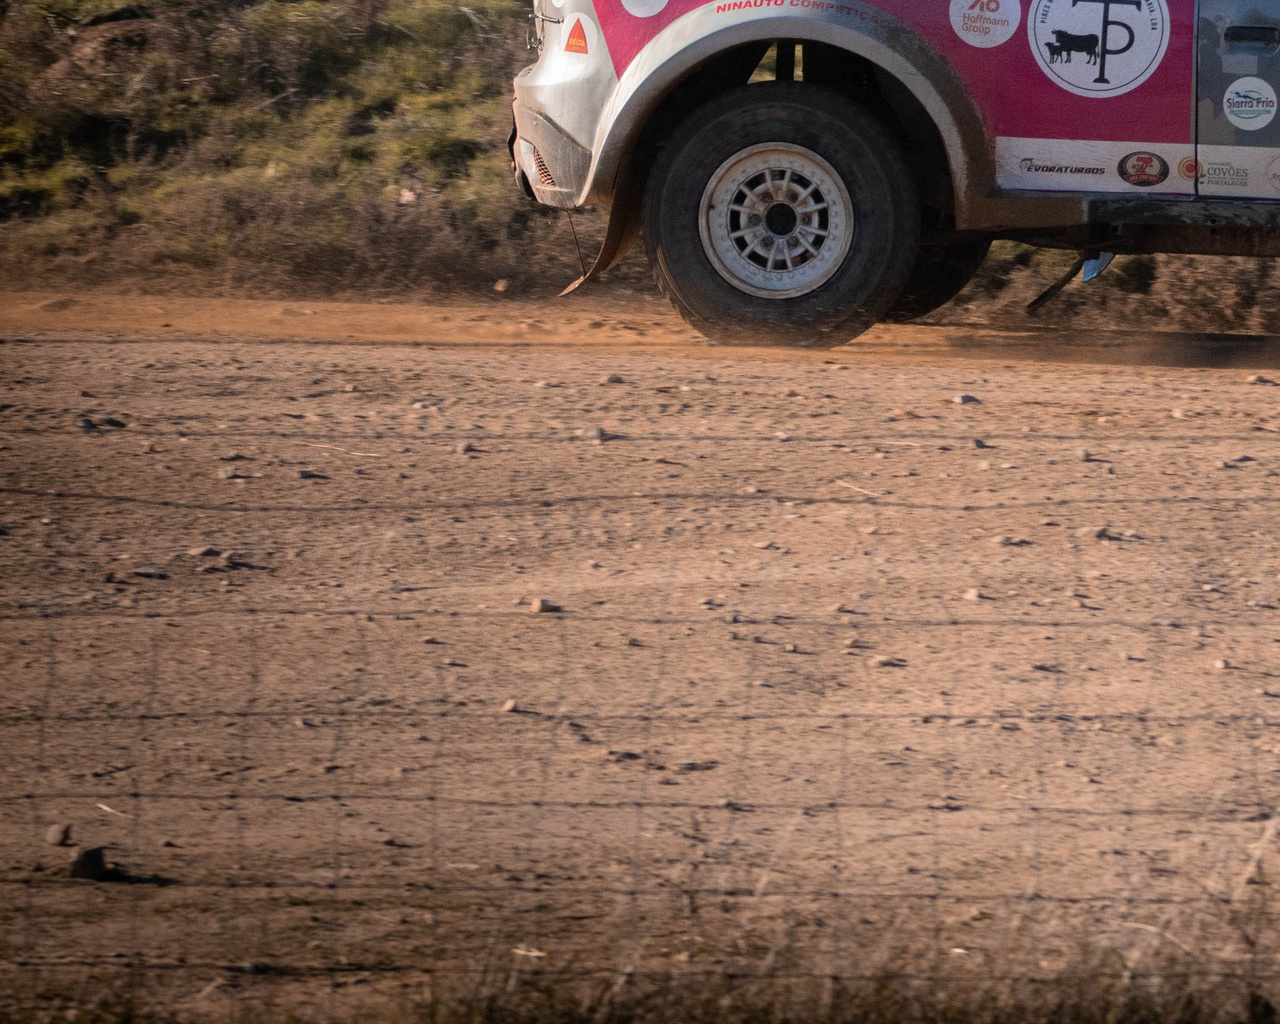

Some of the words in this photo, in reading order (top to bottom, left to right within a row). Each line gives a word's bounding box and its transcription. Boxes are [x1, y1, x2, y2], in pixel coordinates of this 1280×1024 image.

[963, 13, 1010, 27] Hoffmann
[1040, 4, 1051, 24] PIRES
[962, 22, 991, 36] Group
[569, 39, 585, 47] DELTA
[1226, 97, 1254, 108] Sierra
[1026, 165, 1106, 175] EVORATURBOS
[1207, 166, 1249, 178] COVÕES
